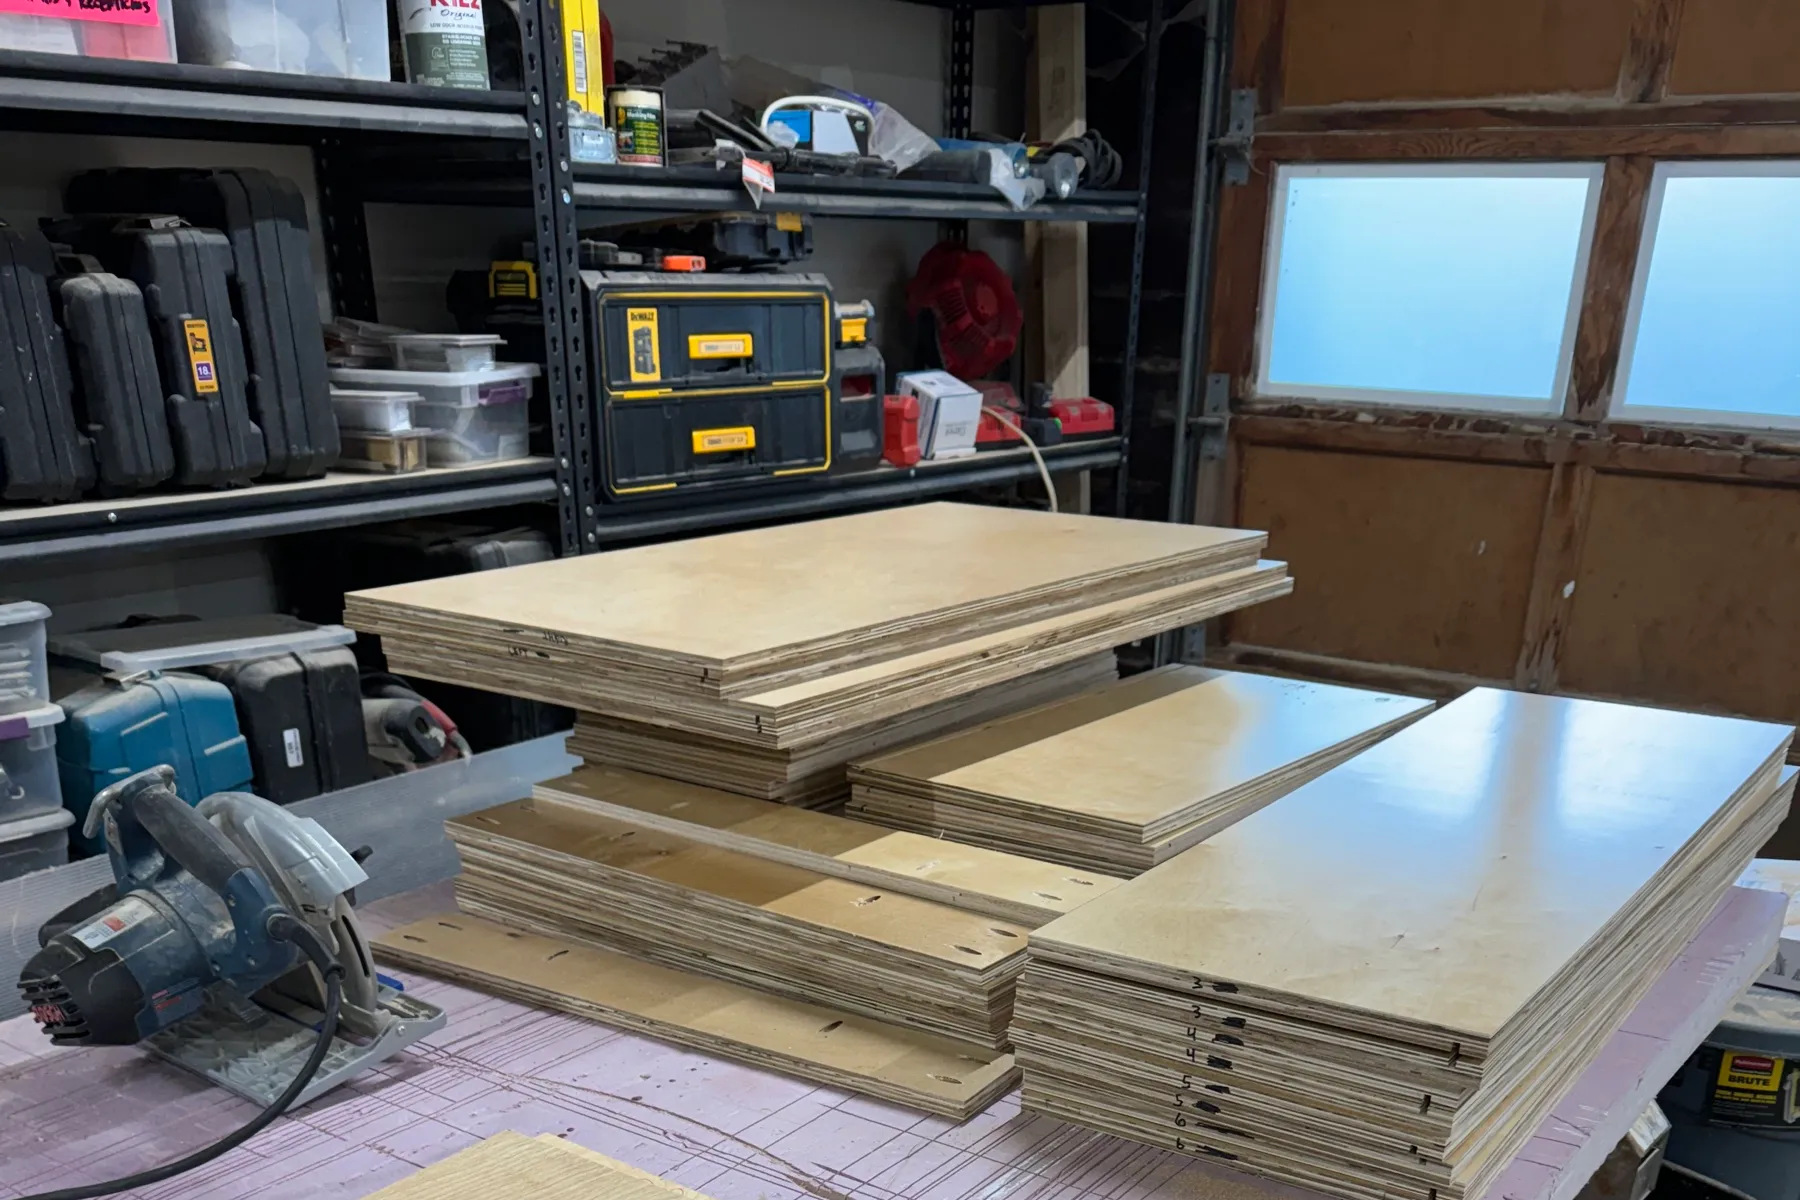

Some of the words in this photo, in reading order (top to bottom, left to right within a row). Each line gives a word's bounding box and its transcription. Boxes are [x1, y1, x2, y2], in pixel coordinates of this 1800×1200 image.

[440, 9, 477, 20] Original
[1192, 976, 1203, 989] 3
[1192, 1005, 1202, 1018] 3
[1187, 1027, 1197, 1041] 4
[1186, 1048, 1196, 1063] 4
[1181, 1075, 1192, 1089] 5
[1728, 1074, 1771, 1087] BRUTE
[1173, 1094, 1184, 1107] 5
[1175, 1113, 1187, 1127] 6
